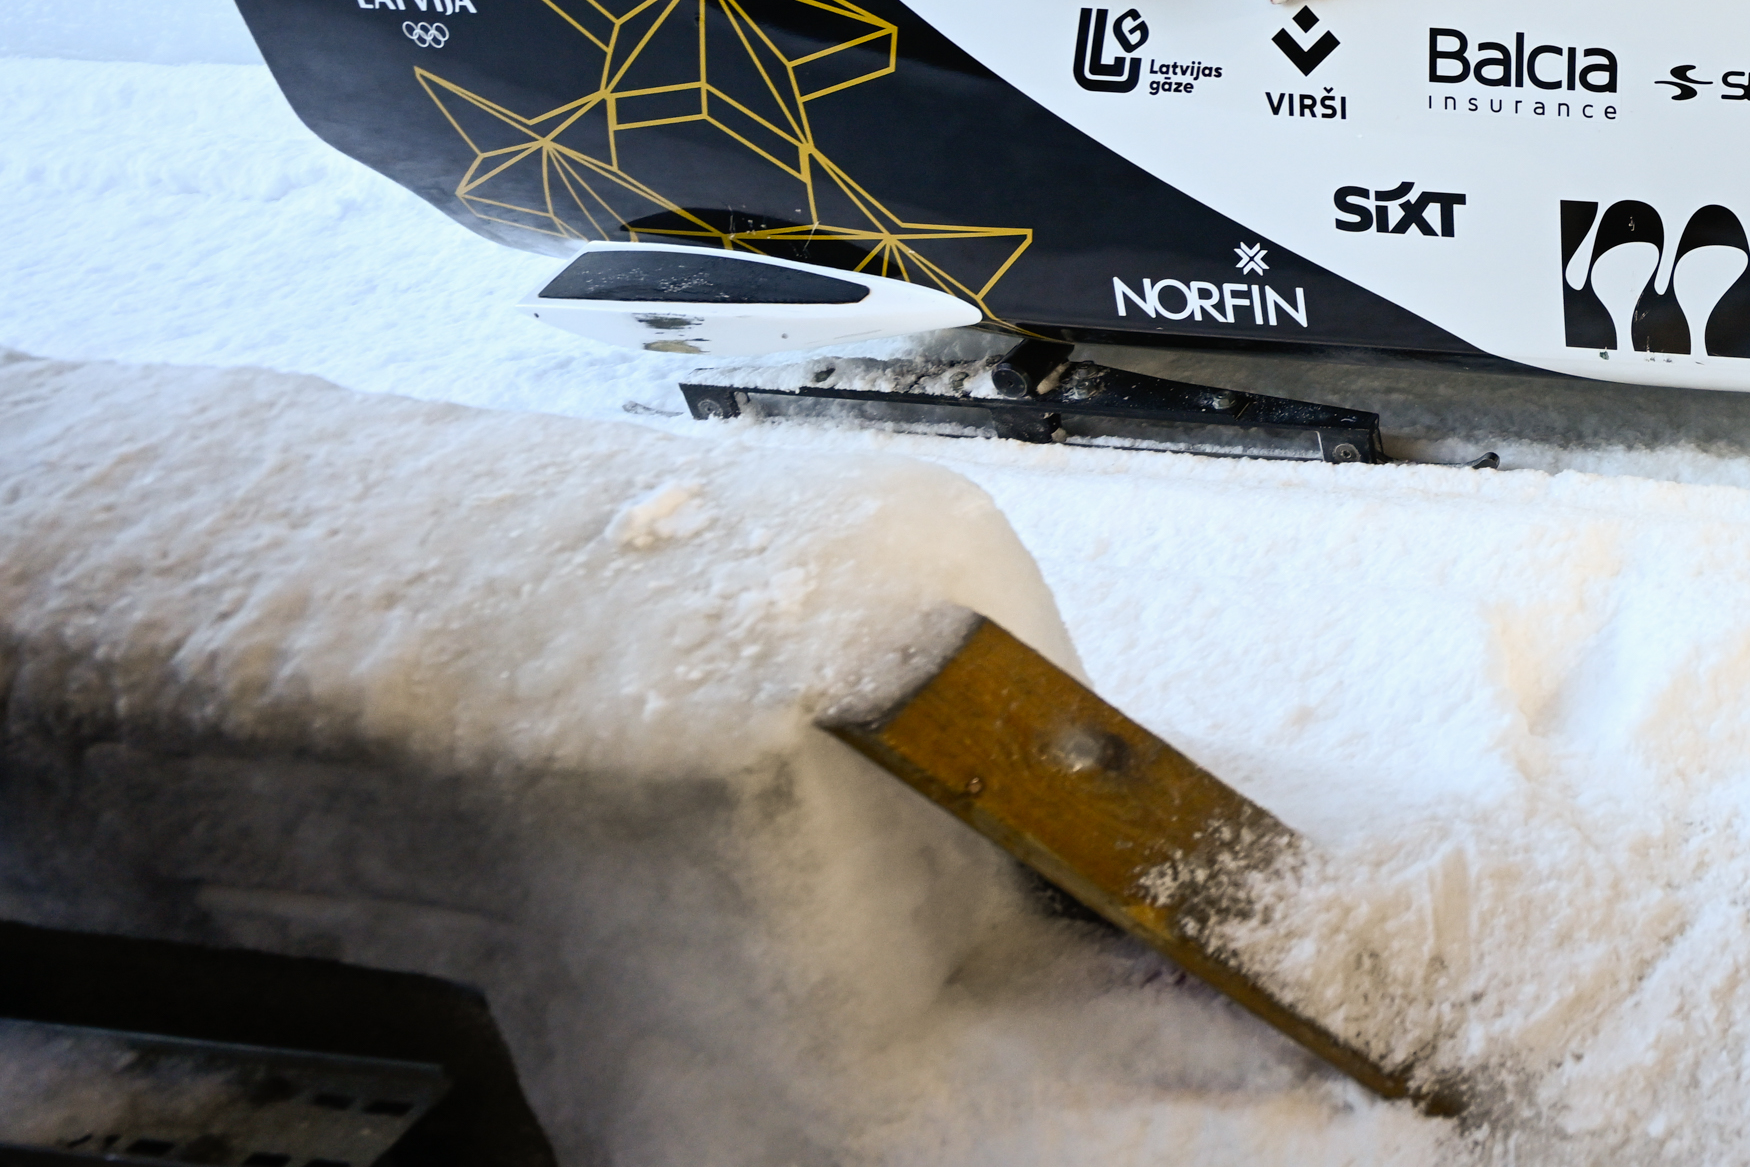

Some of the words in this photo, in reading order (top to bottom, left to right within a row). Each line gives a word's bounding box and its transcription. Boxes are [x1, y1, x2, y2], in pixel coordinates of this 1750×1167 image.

[1149, 59, 1223, 80] Latvijas
[1429, 27, 1618, 93] Balcia
[1149, 76, 1194, 95] gāze
[1265, 86, 1347, 120] VIRŠI
[1428, 95, 1617, 120] insurance
[1112, 276, 1308, 328] NORFIN
